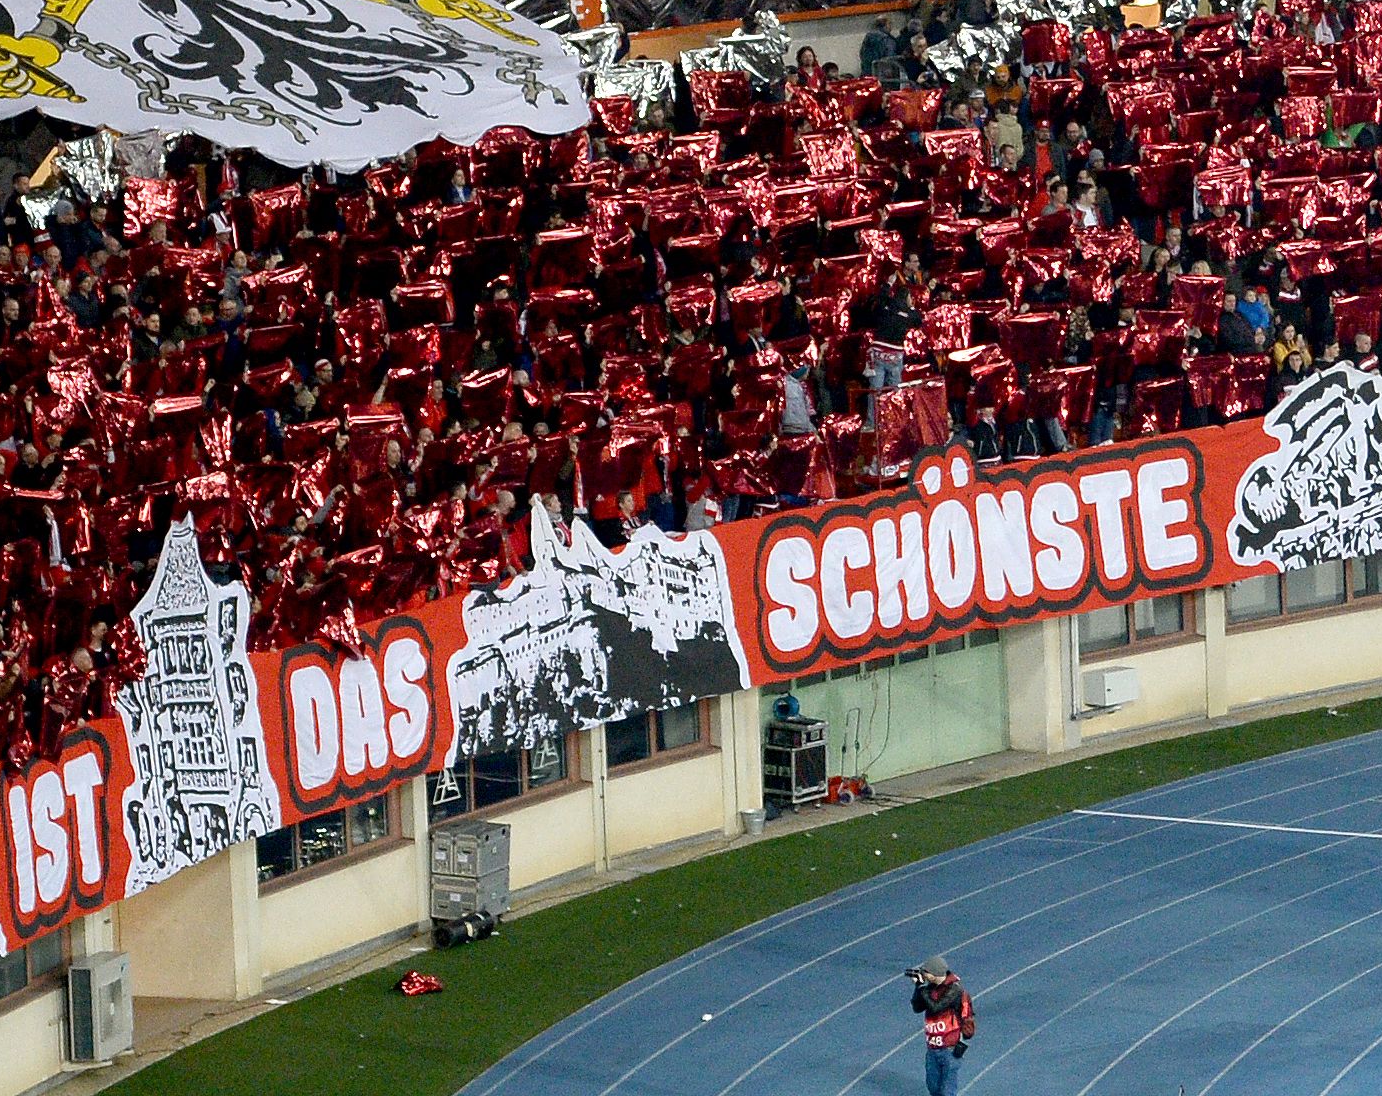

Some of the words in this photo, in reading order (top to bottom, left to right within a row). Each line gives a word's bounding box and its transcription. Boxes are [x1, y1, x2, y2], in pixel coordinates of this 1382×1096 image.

[8, 752, 104, 914] IST
[290, 637, 430, 791] DAS
[765, 456, 1198, 652] SCHÖNSTE
